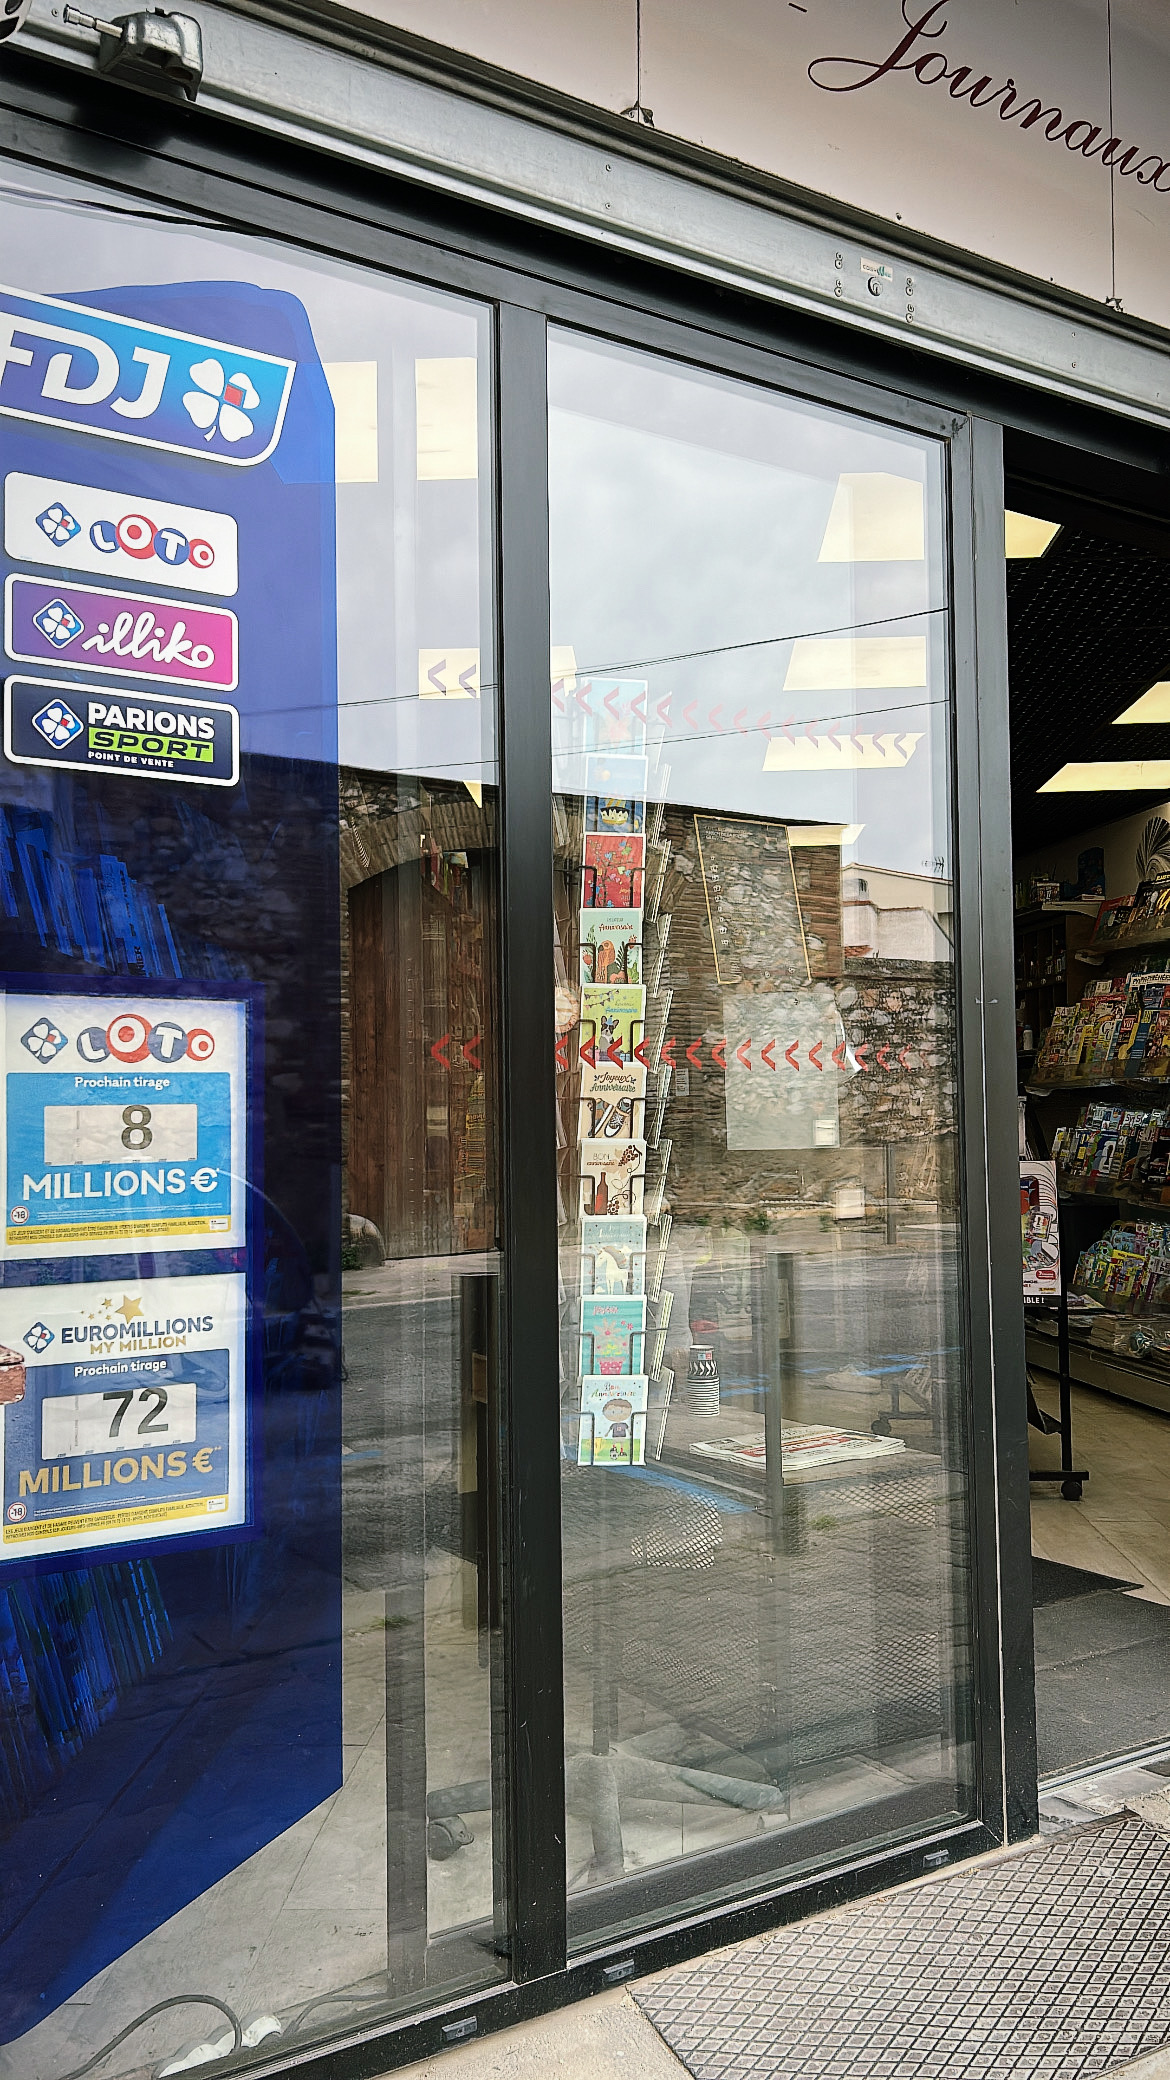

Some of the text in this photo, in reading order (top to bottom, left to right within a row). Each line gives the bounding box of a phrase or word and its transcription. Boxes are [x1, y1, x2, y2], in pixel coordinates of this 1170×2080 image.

[808, 0, 1170, 192] Journaux
[90, 513, 215, 569] LOTO
[81, 611, 215, 669] illiko
[88, 702, 215, 739] PARIONS
[87, 750, 175, 769] POINT DE VENTE
[90, 731, 213, 759] SPORT
[77, 1013, 215, 1064] LOTO
[75, 1076, 170, 1091] Prochain tirage
[121, 1104, 153, 1150] 8
[23, 1169, 187, 1201] MILLIONS
[62, 1316, 214, 1344] EUROMILLIONS
[90, 1335, 187, 1355] MY MILLION
[74, 1359, 167, 1377] Prochain tirage
[102, 1388, 169, 1438] 72
[19, 1450, 187, 1497] MILLIONS
[11, 1507, 23, 1517] -18
